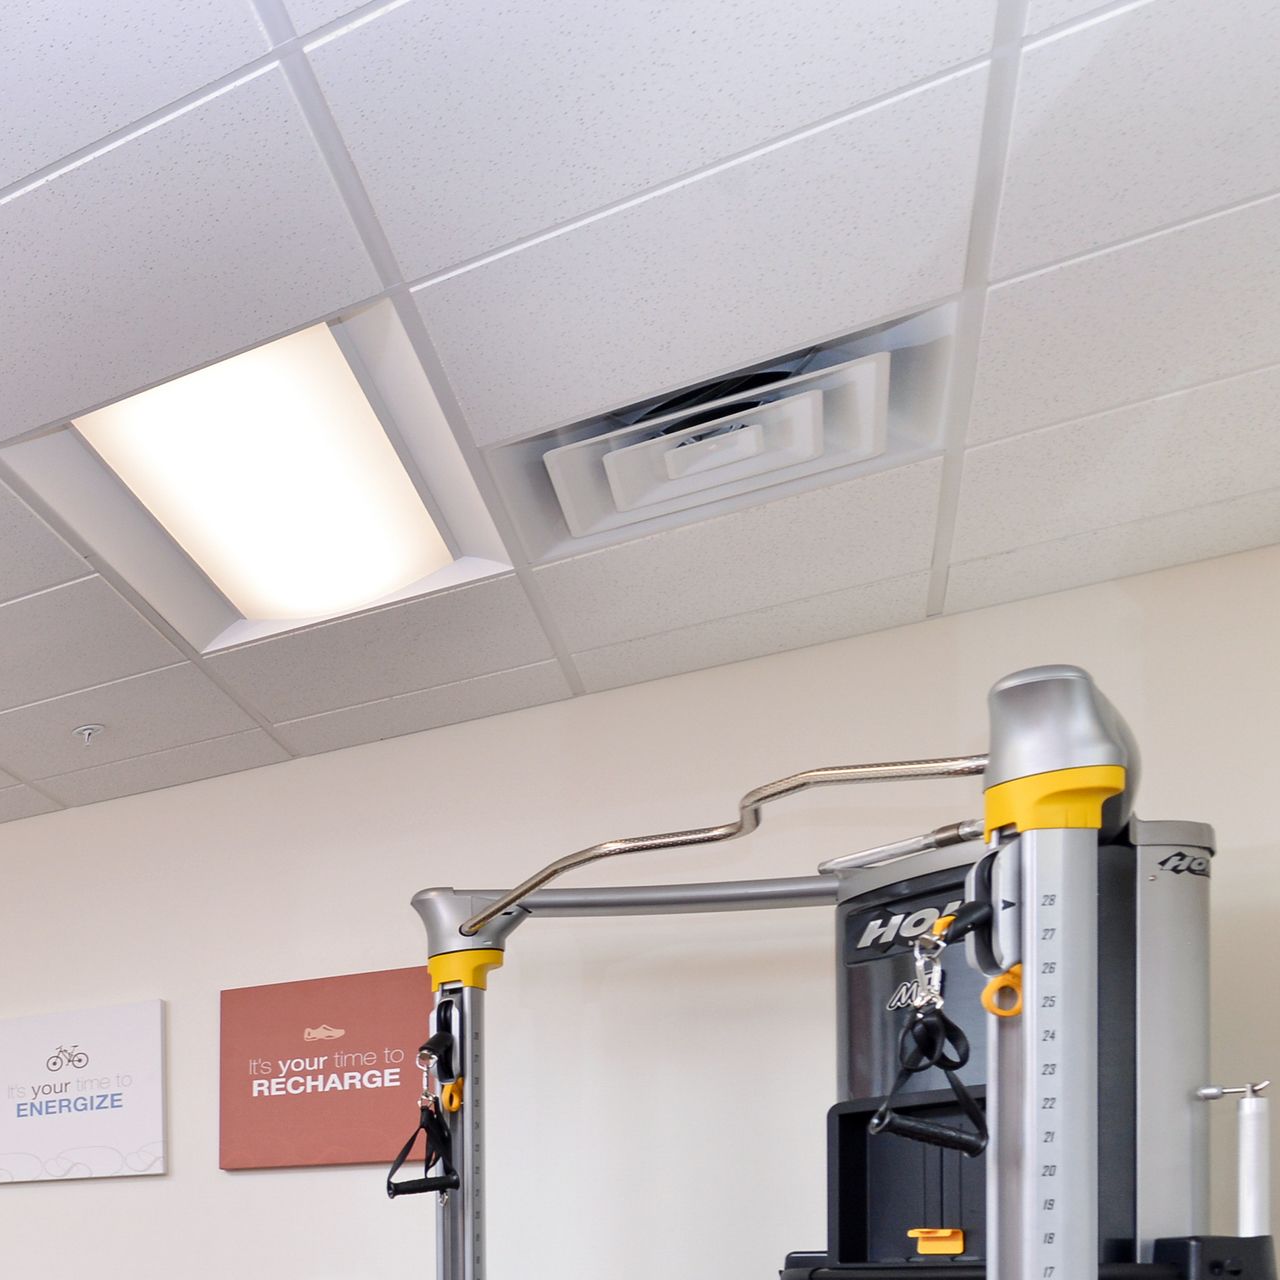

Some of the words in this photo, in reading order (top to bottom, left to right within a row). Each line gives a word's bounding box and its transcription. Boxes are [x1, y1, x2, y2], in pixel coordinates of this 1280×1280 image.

[1040, 893, 1057, 907] 28
[1040, 927, 1057, 941] 27
[1040, 961, 1057, 975] 26
[1040, 995, 1057, 1008] 25
[1041, 1029, 1056, 1042] 24
[249, 1058, 272, 1075] It's
[278, 1056, 328, 1077] your
[333, 1051, 377, 1068] time
[384, 1048, 404, 1064] to
[1040, 1063, 1057, 1076] 23
[8, 1084, 26, 1099] It's
[31, 1081, 71, 1100] your
[76, 1077, 111, 1092] time
[116, 1073, 133, 1088] to
[252, 1068, 401, 1097] RECHARGE
[16, 1093, 124, 1118] ENERGIZE
[1040, 1096, 1057, 1110] 22
[1042, 1130, 1056, 1144] 21
[1040, 1164, 1057, 1177] 20
[1042, 1198, 1056, 1211] 19
[1043, 1231, 1056, 1245] 18
[1043, 1265, 1056, 1279] 17
